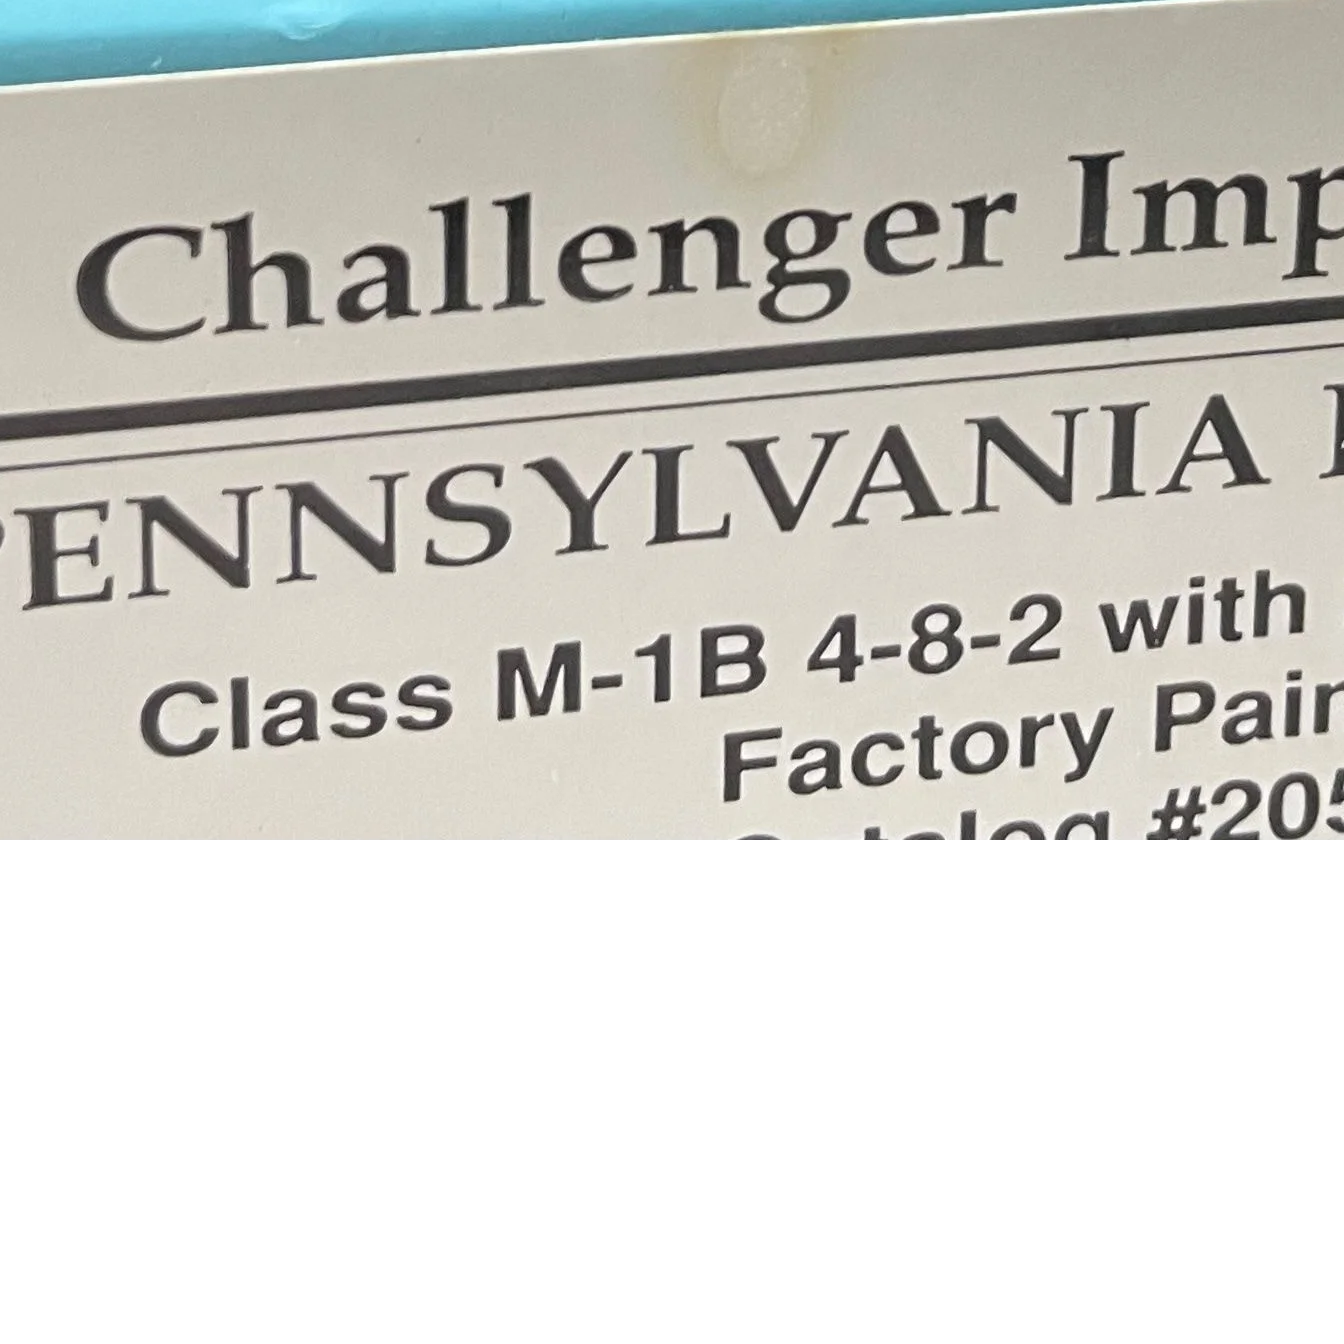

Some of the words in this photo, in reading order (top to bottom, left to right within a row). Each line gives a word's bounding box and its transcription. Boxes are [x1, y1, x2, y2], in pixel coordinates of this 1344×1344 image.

[74, 191, 1019, 343] Challenger
[139, 676, 454, 759] Class
[496, 624, 768, 723] M-1B
[806, 593, 1063, 684] 4-8-2
[1097, 569, 1307, 654] with
[722, 707, 1115, 804] Factory
